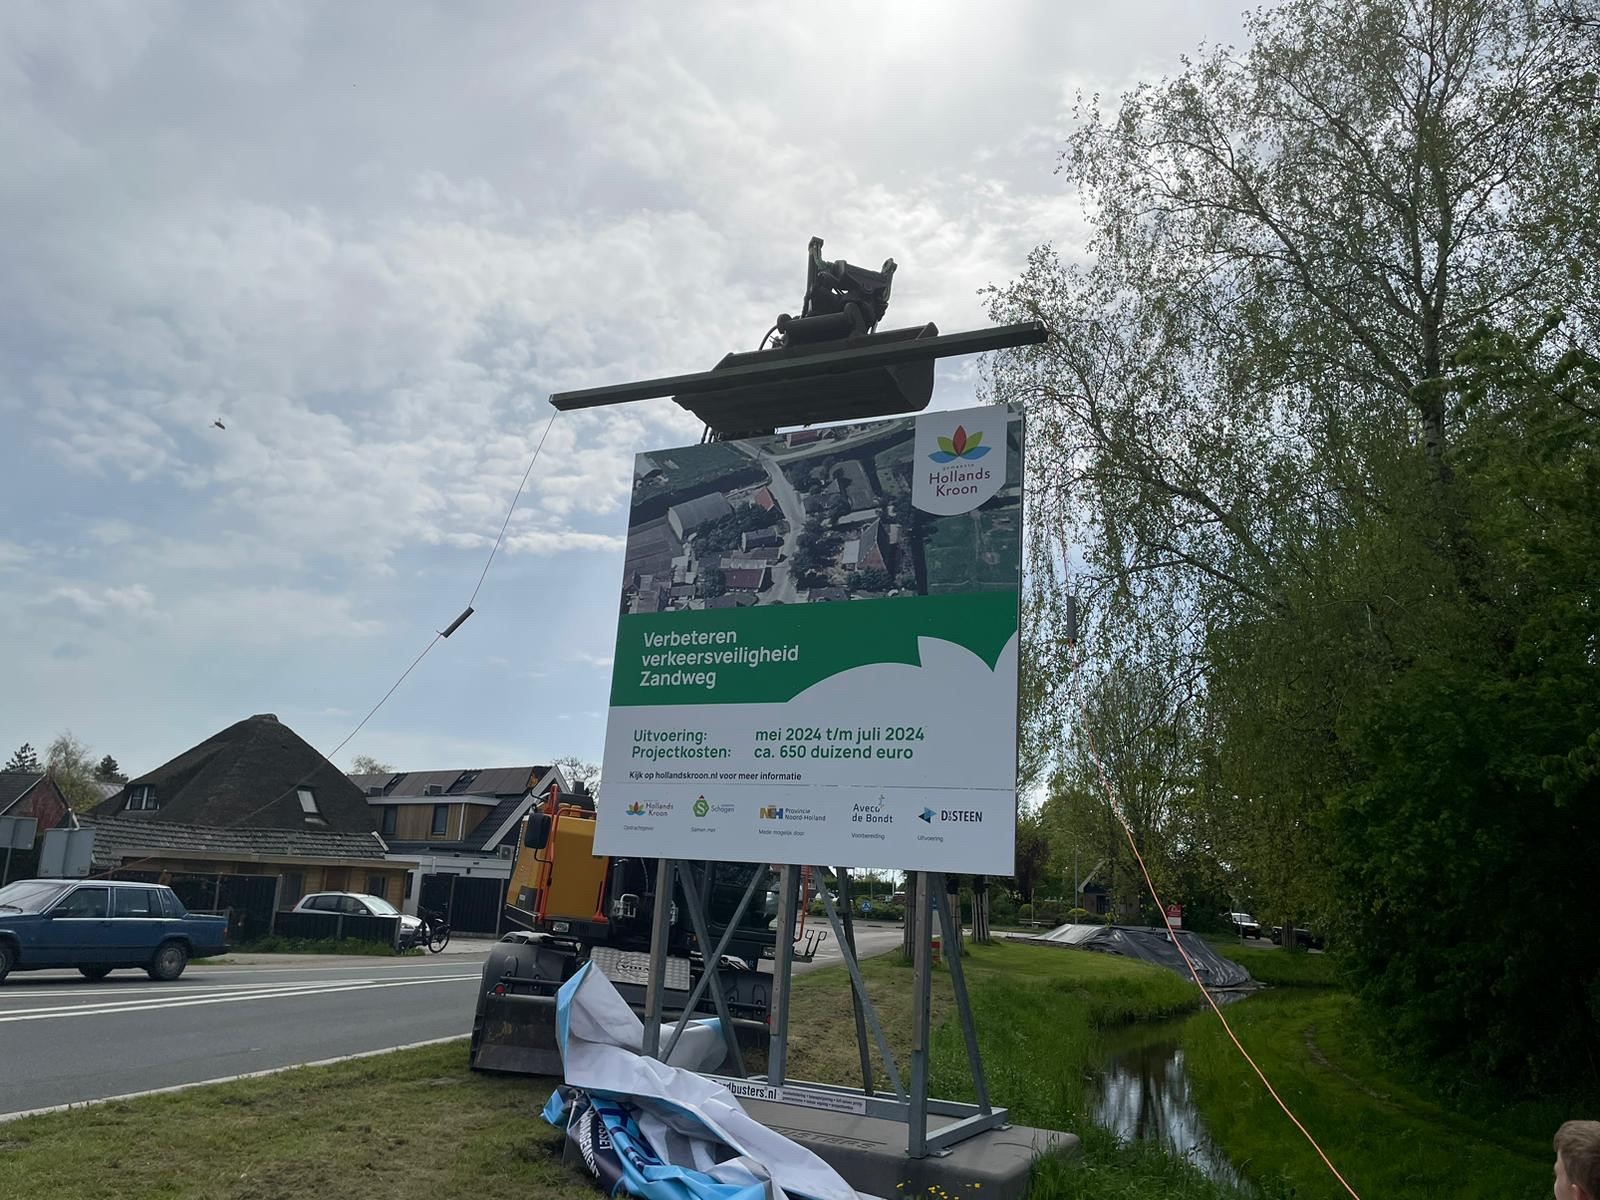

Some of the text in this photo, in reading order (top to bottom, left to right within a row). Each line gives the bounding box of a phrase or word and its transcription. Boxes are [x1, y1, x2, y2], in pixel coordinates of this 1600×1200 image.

[929, 467, 991, 485] Hollands
[936, 485, 978, 497] Kroon
[643, 630, 737, 648] Verbeteren
[641, 645, 799, 668] verkeersveiligheid
[639, 669, 717, 690] Zandweg
[633, 727, 925, 746] Uitvoering: mei 2024 t/m juli 2024
[631, 745, 913, 761] Projectkosten: ca. 650 duizend euro
[629, 771, 643, 780] Kijk
[655, 771, 718, 780] hollandskroon.nl
[760, 771, 801, 781] informatie
[645, 802, 675, 811] Hollands
[648, 809, 669, 817] Kroon
[853, 803, 881, 814] Aveco
[852, 813, 894, 824] de Bondt
